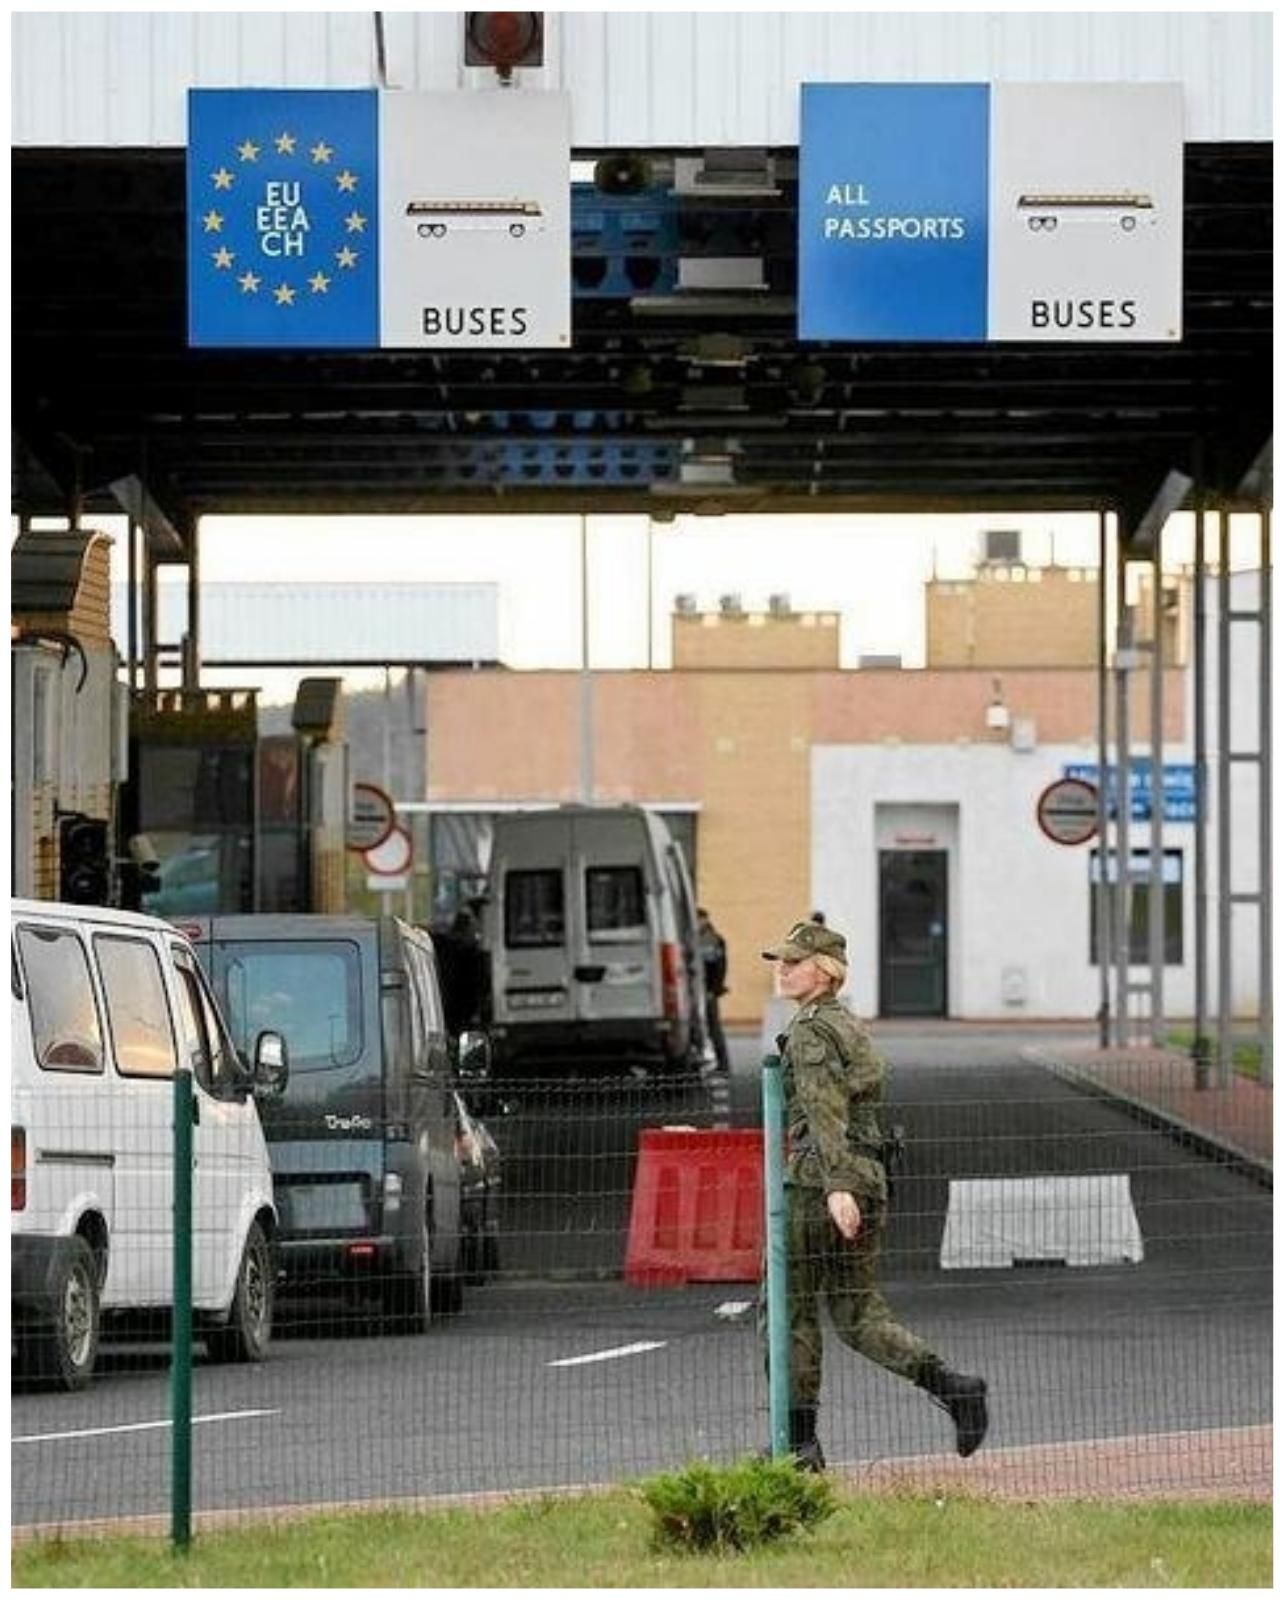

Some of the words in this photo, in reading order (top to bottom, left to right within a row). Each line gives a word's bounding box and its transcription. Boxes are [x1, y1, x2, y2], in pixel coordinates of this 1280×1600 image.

[266, 182, 300, 207] EU
[825, 184, 869, 206] ALL
[256, 207, 311, 231] EEA
[824, 217, 965, 239] PASSPORTS
[261, 231, 304, 257] CH
[422, 307, 528, 336] BUSES
[1030, 300, 1137, 329] BUSES
